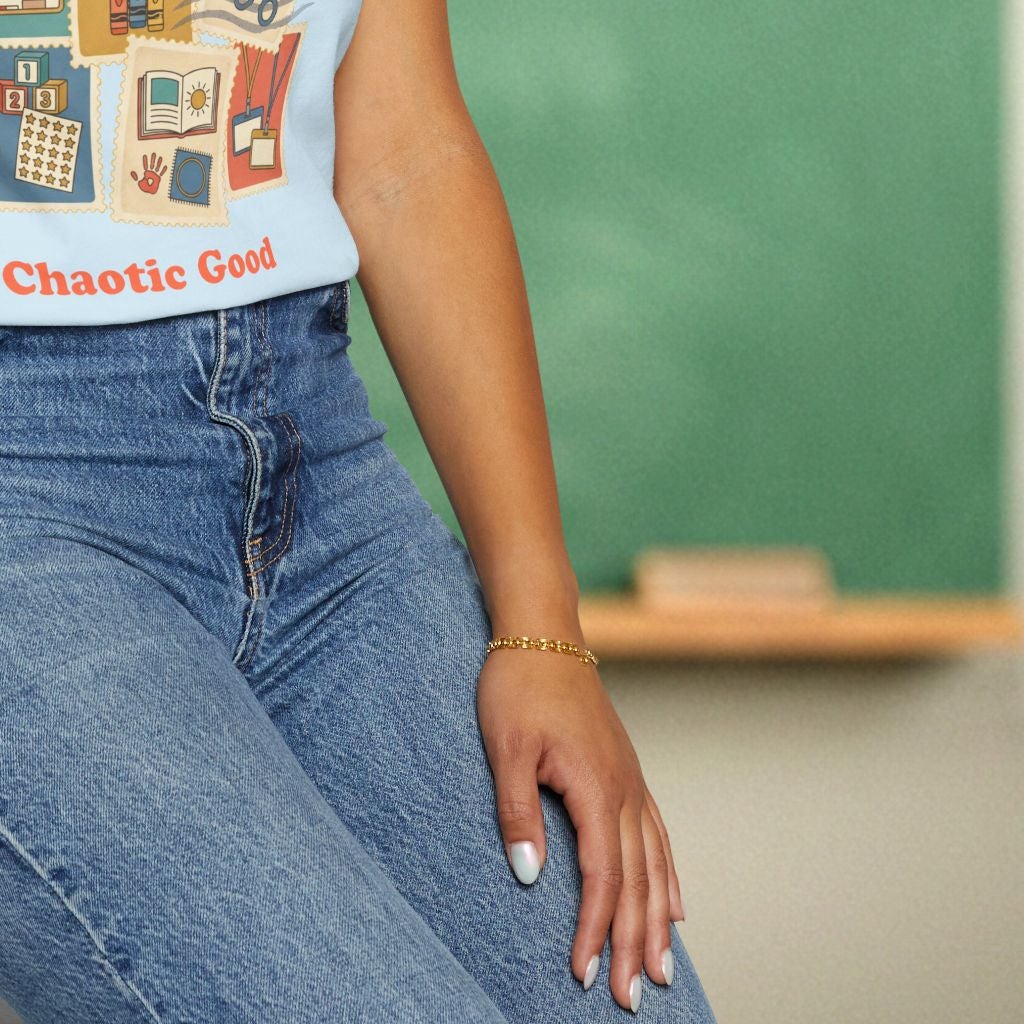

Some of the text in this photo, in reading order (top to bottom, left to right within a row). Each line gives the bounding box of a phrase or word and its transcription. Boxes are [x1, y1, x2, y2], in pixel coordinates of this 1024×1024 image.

[23, 63, 30, 81] 1
[9, 91, 20, 109] 2
[40, 91, 51, 108] 3
[2, 236, 276, 296] Chaotic Good
